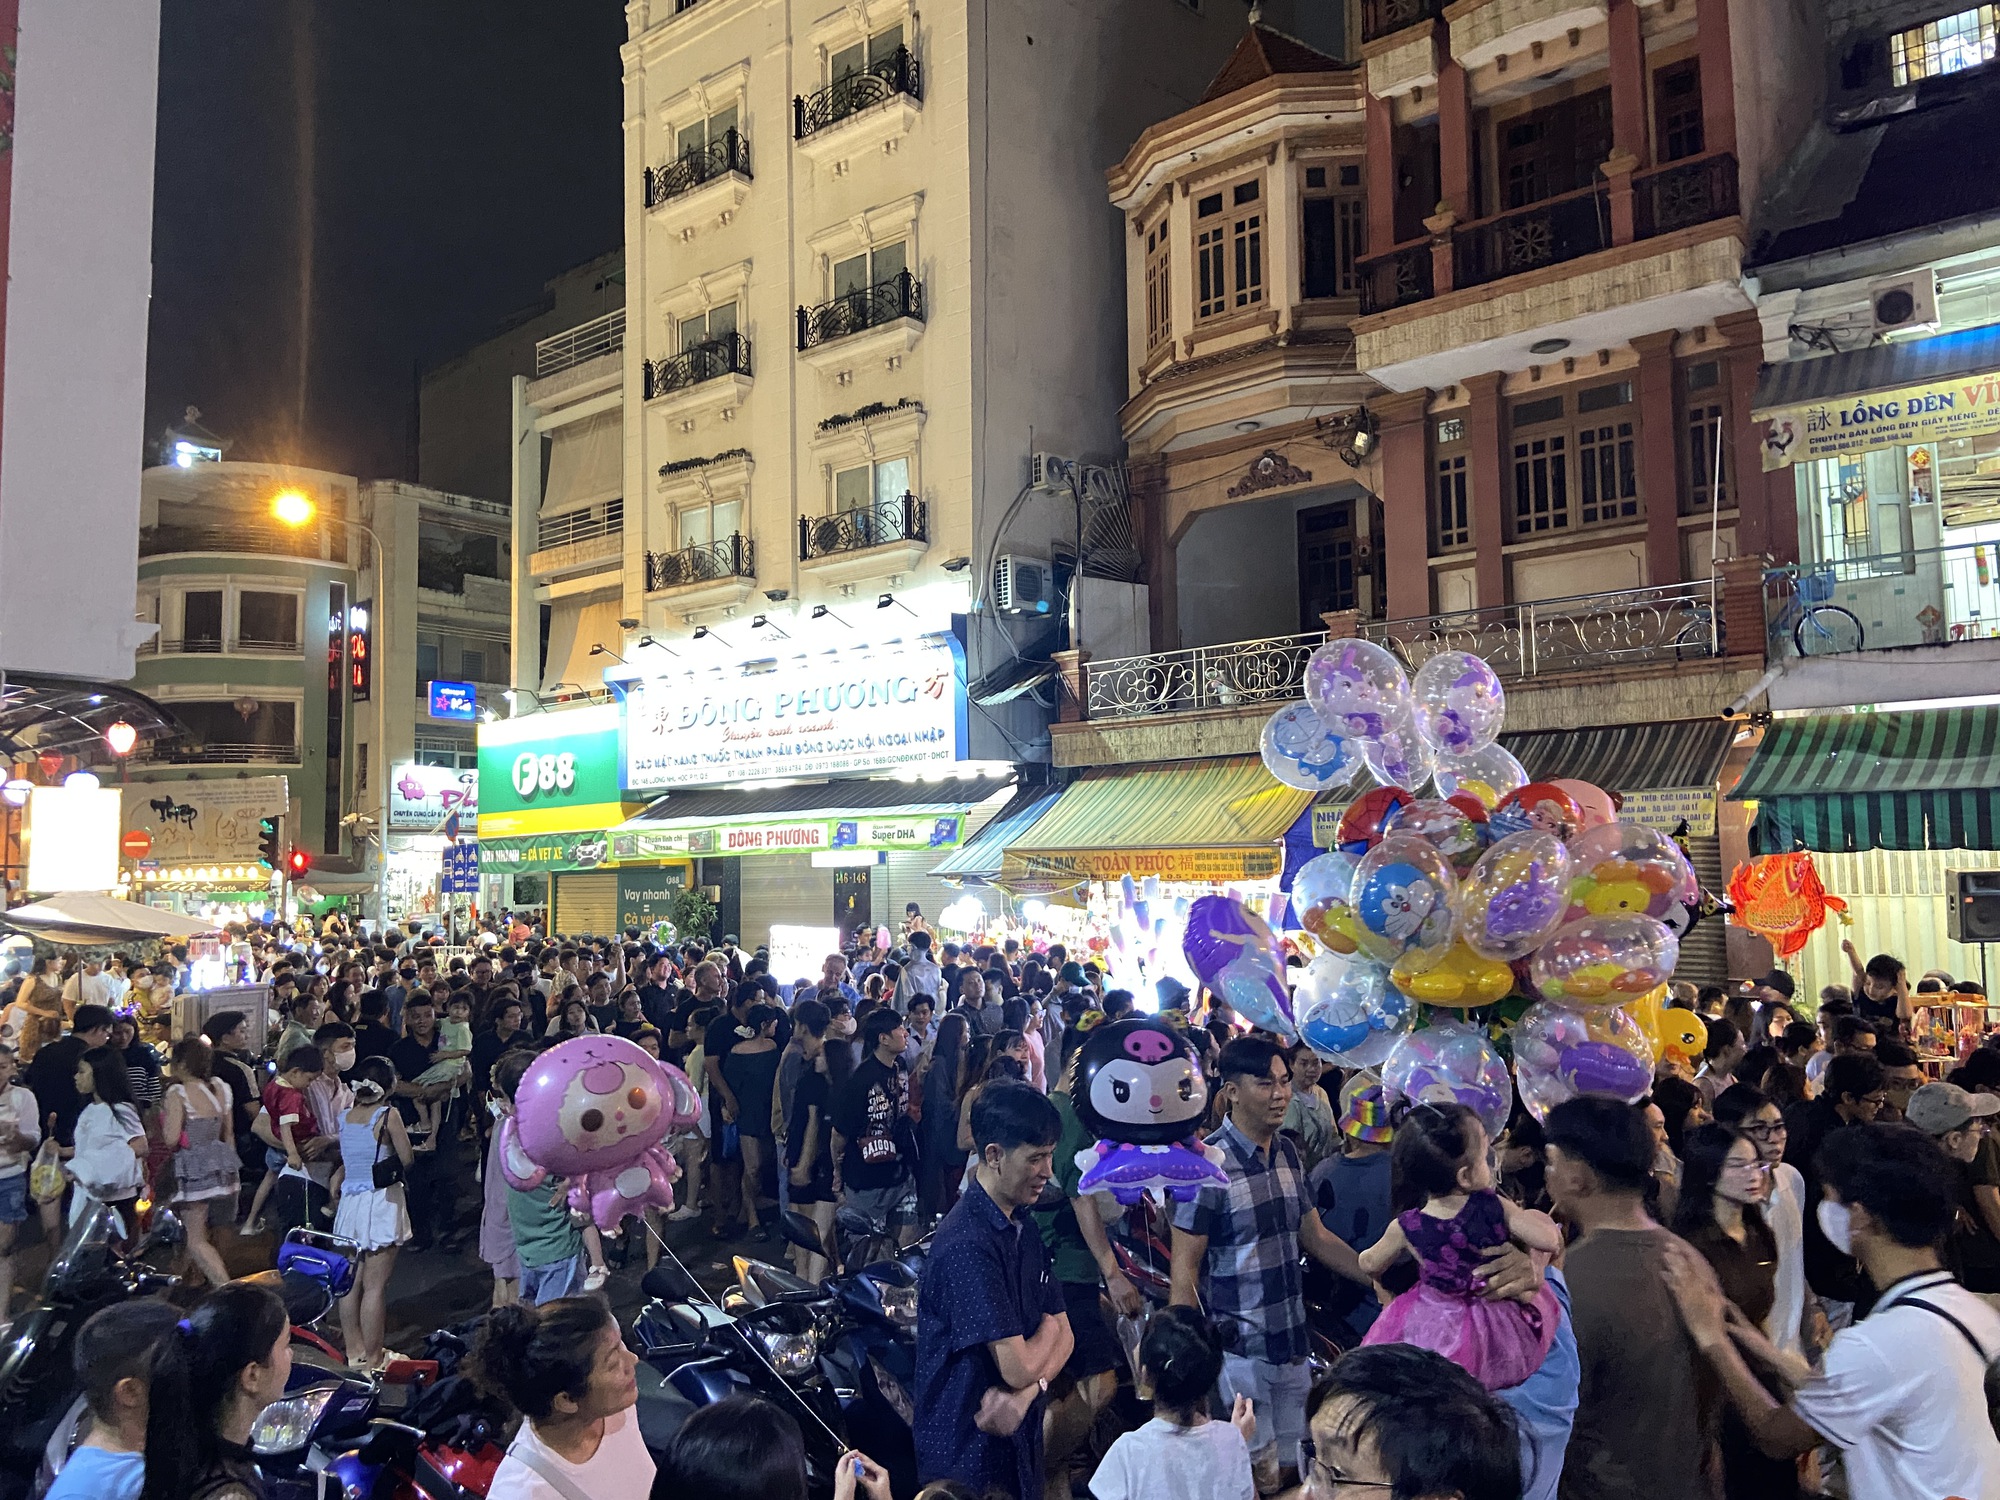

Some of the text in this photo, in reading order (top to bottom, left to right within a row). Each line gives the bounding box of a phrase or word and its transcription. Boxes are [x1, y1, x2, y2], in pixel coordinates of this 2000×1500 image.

[1840, 376, 2000, 427] LỒNG ĐÈN VĨ
[678, 677, 918, 731] ĐÔNG PHƯƠNG
[512, 752, 576, 796] F88
[728, 828, 819, 848] ĐÔNG PHƯƠNG
[872, 829, 916, 841] Super DHA
[1054, 856, 1077, 870] MAY
[1093, 851, 1130, 871] TOÀN
[1135, 850, 1175, 871] PHÚC
[624, 888, 670, 902] Vay nhanh
[624, 912, 638, 925] Cà
[862, 1139, 897, 1160] SAIGON
